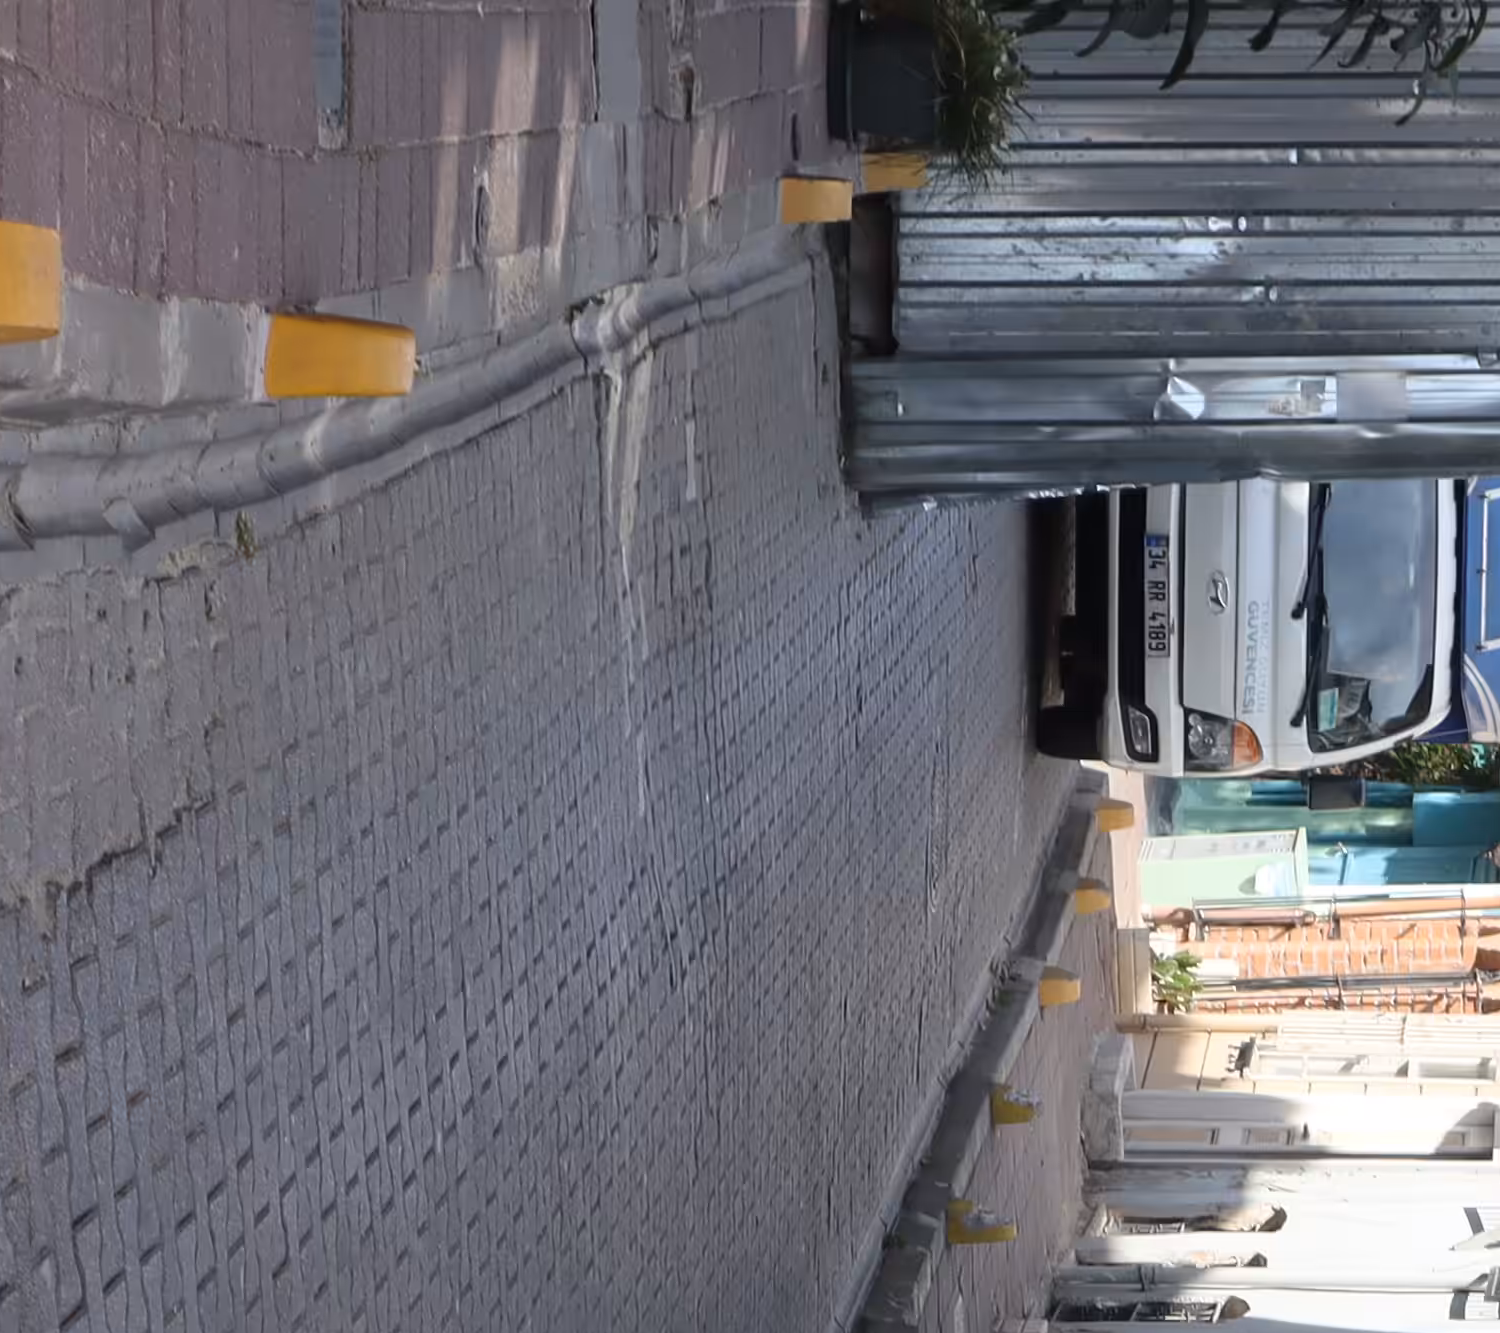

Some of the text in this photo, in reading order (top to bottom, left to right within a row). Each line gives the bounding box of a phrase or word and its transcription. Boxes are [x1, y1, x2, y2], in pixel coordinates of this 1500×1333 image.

[1148, 549, 1166, 652] 34 RR 4189
